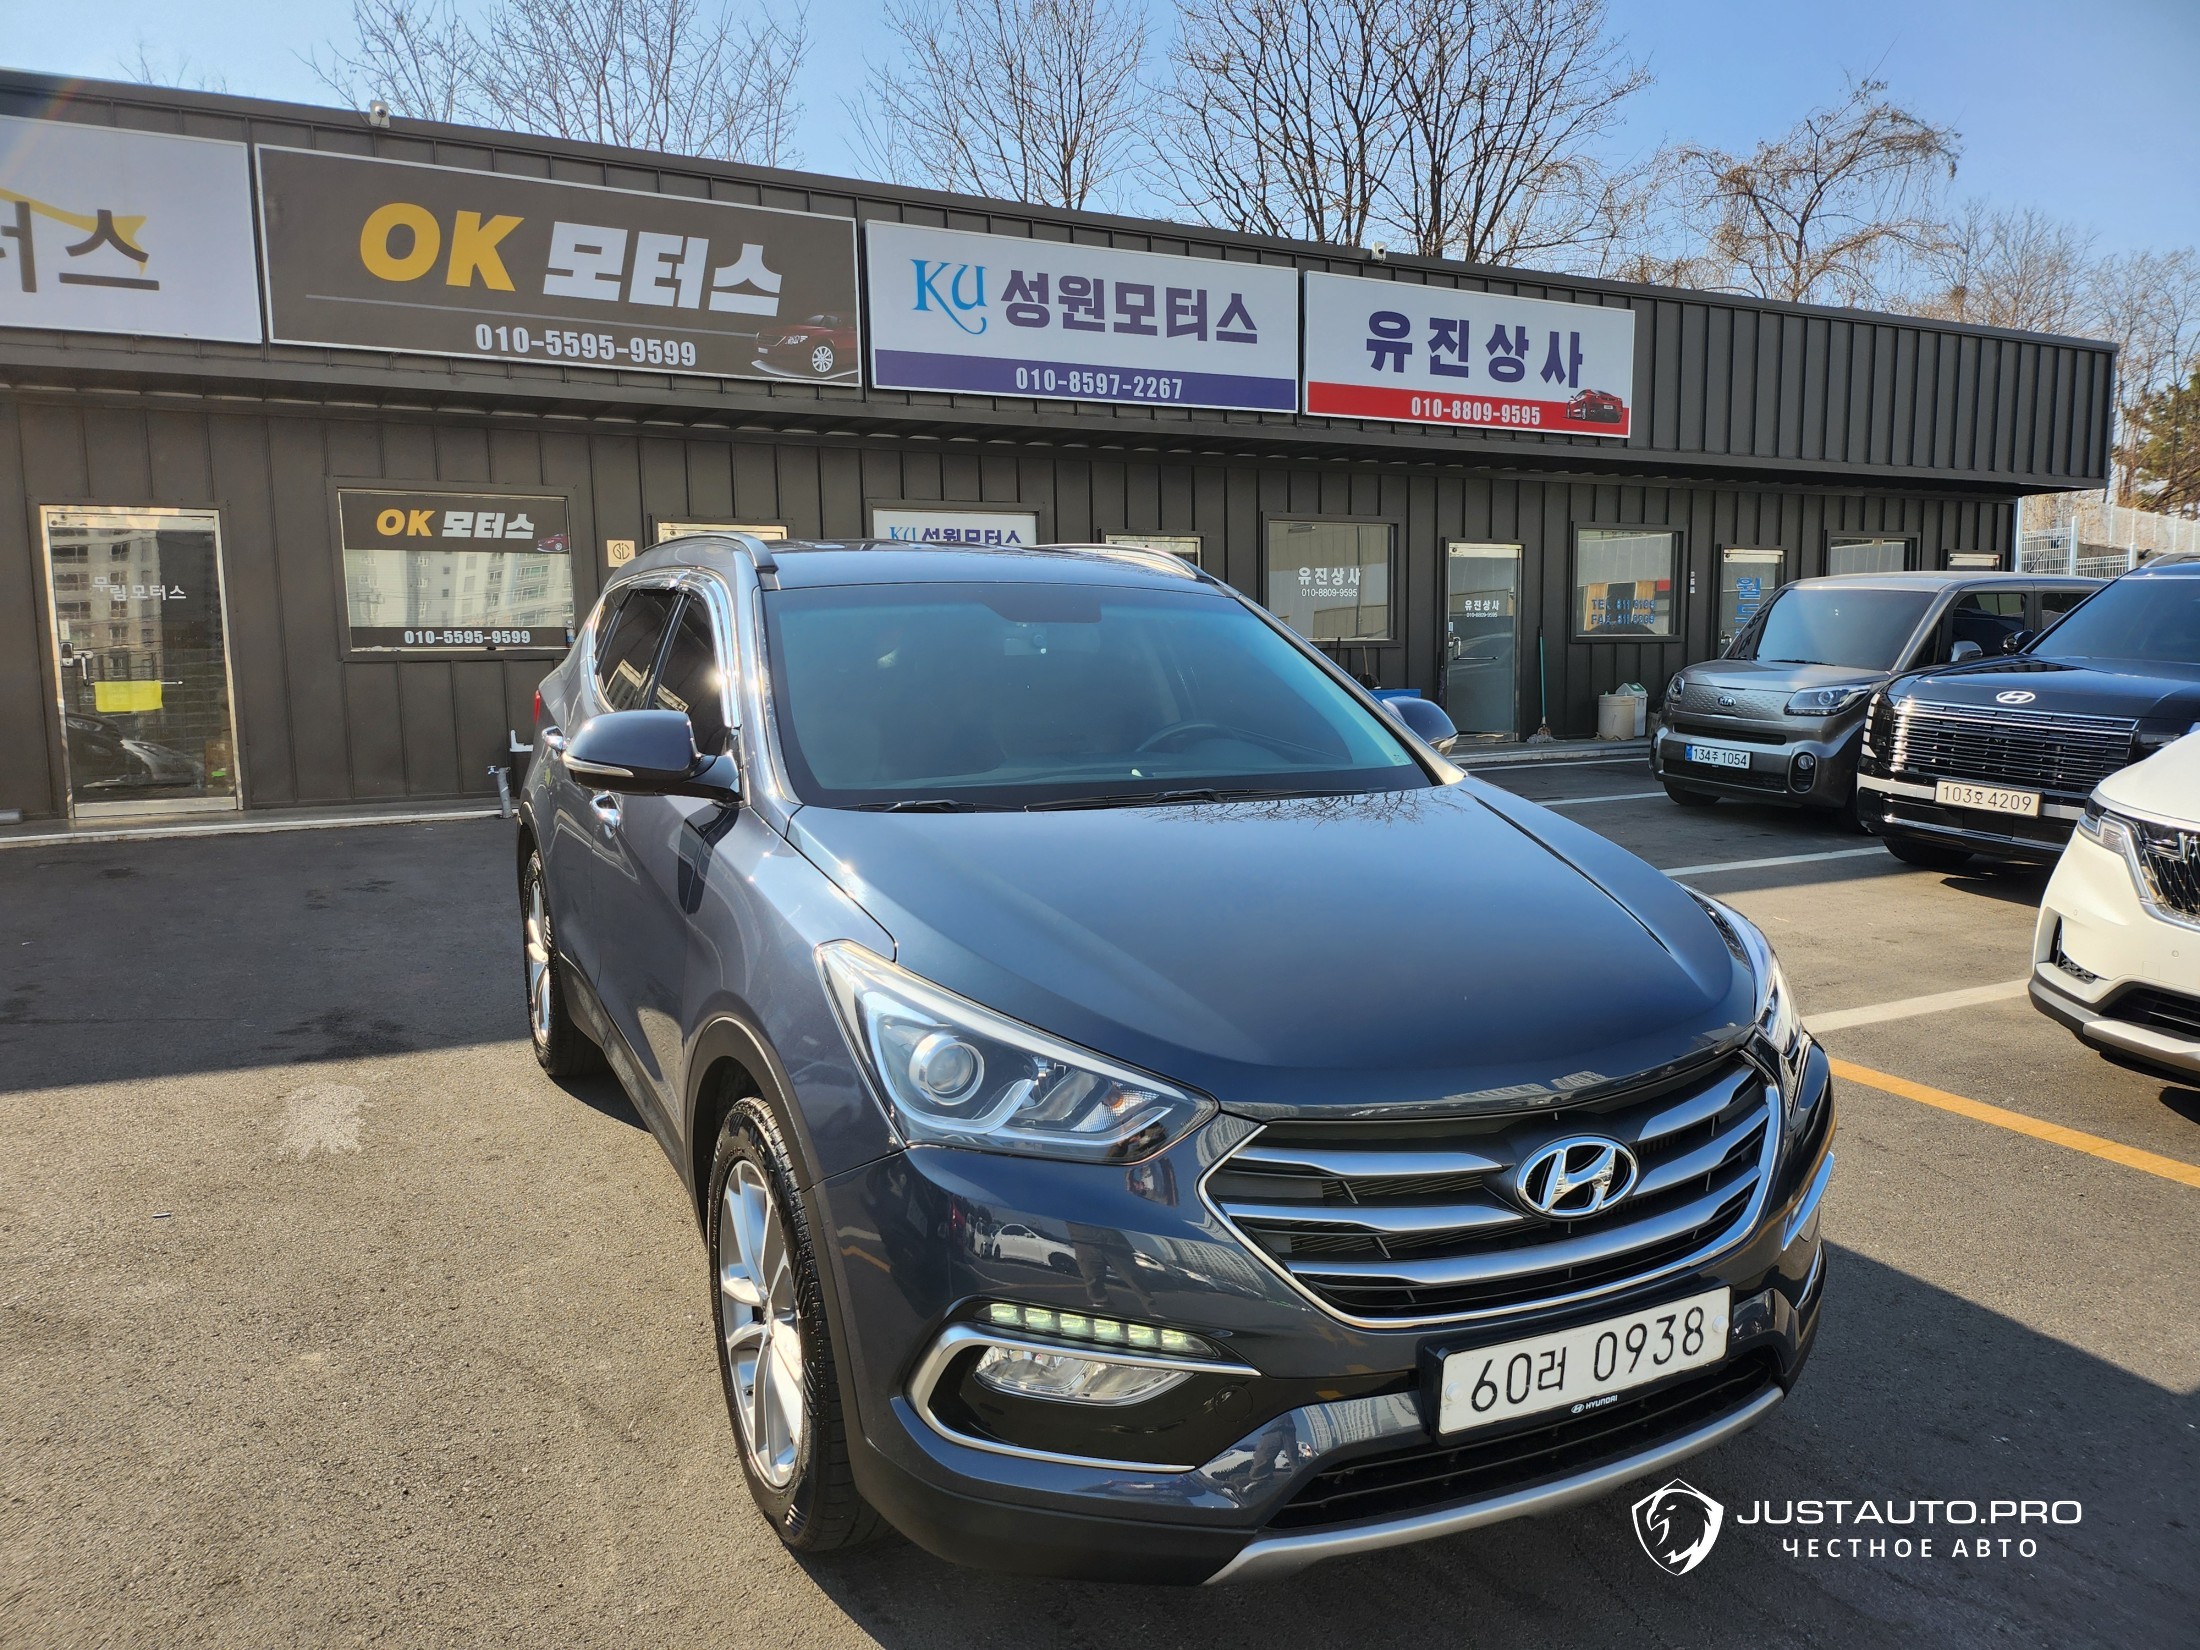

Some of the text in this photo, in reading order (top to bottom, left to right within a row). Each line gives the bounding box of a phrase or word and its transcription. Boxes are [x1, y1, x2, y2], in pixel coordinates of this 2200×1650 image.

[360, 201, 783, 317] OK 모터스
[1000, 268, 1258, 345] 성원모터스
[474, 323, 697, 367] 010-5595-9599
[1366, 310, 1584, 388] 유진상사
[1015, 366, 1183, 400] 010-8597-2267
[1410, 396, 1541, 426] 010-8809-9595
[376, 508, 535, 540] OK 모터스
[91, 575, 187, 602] 무림모터스
[1297, 566, 1361, 586] 유진상사
[1301, 588, 1358, 597] 010-8809-9595
[1464, 599, 1500, 611] 유진상사
[404, 630, 531, 644] 010-5595-9599
[1693, 748, 1747, 767] 134주 1054
[1943, 785, 2032, 812] 103호 4209
[1470, 1306, 1704, 1413] 60러 0938
[1586, 1394, 1618, 1410] HYUNDAI
